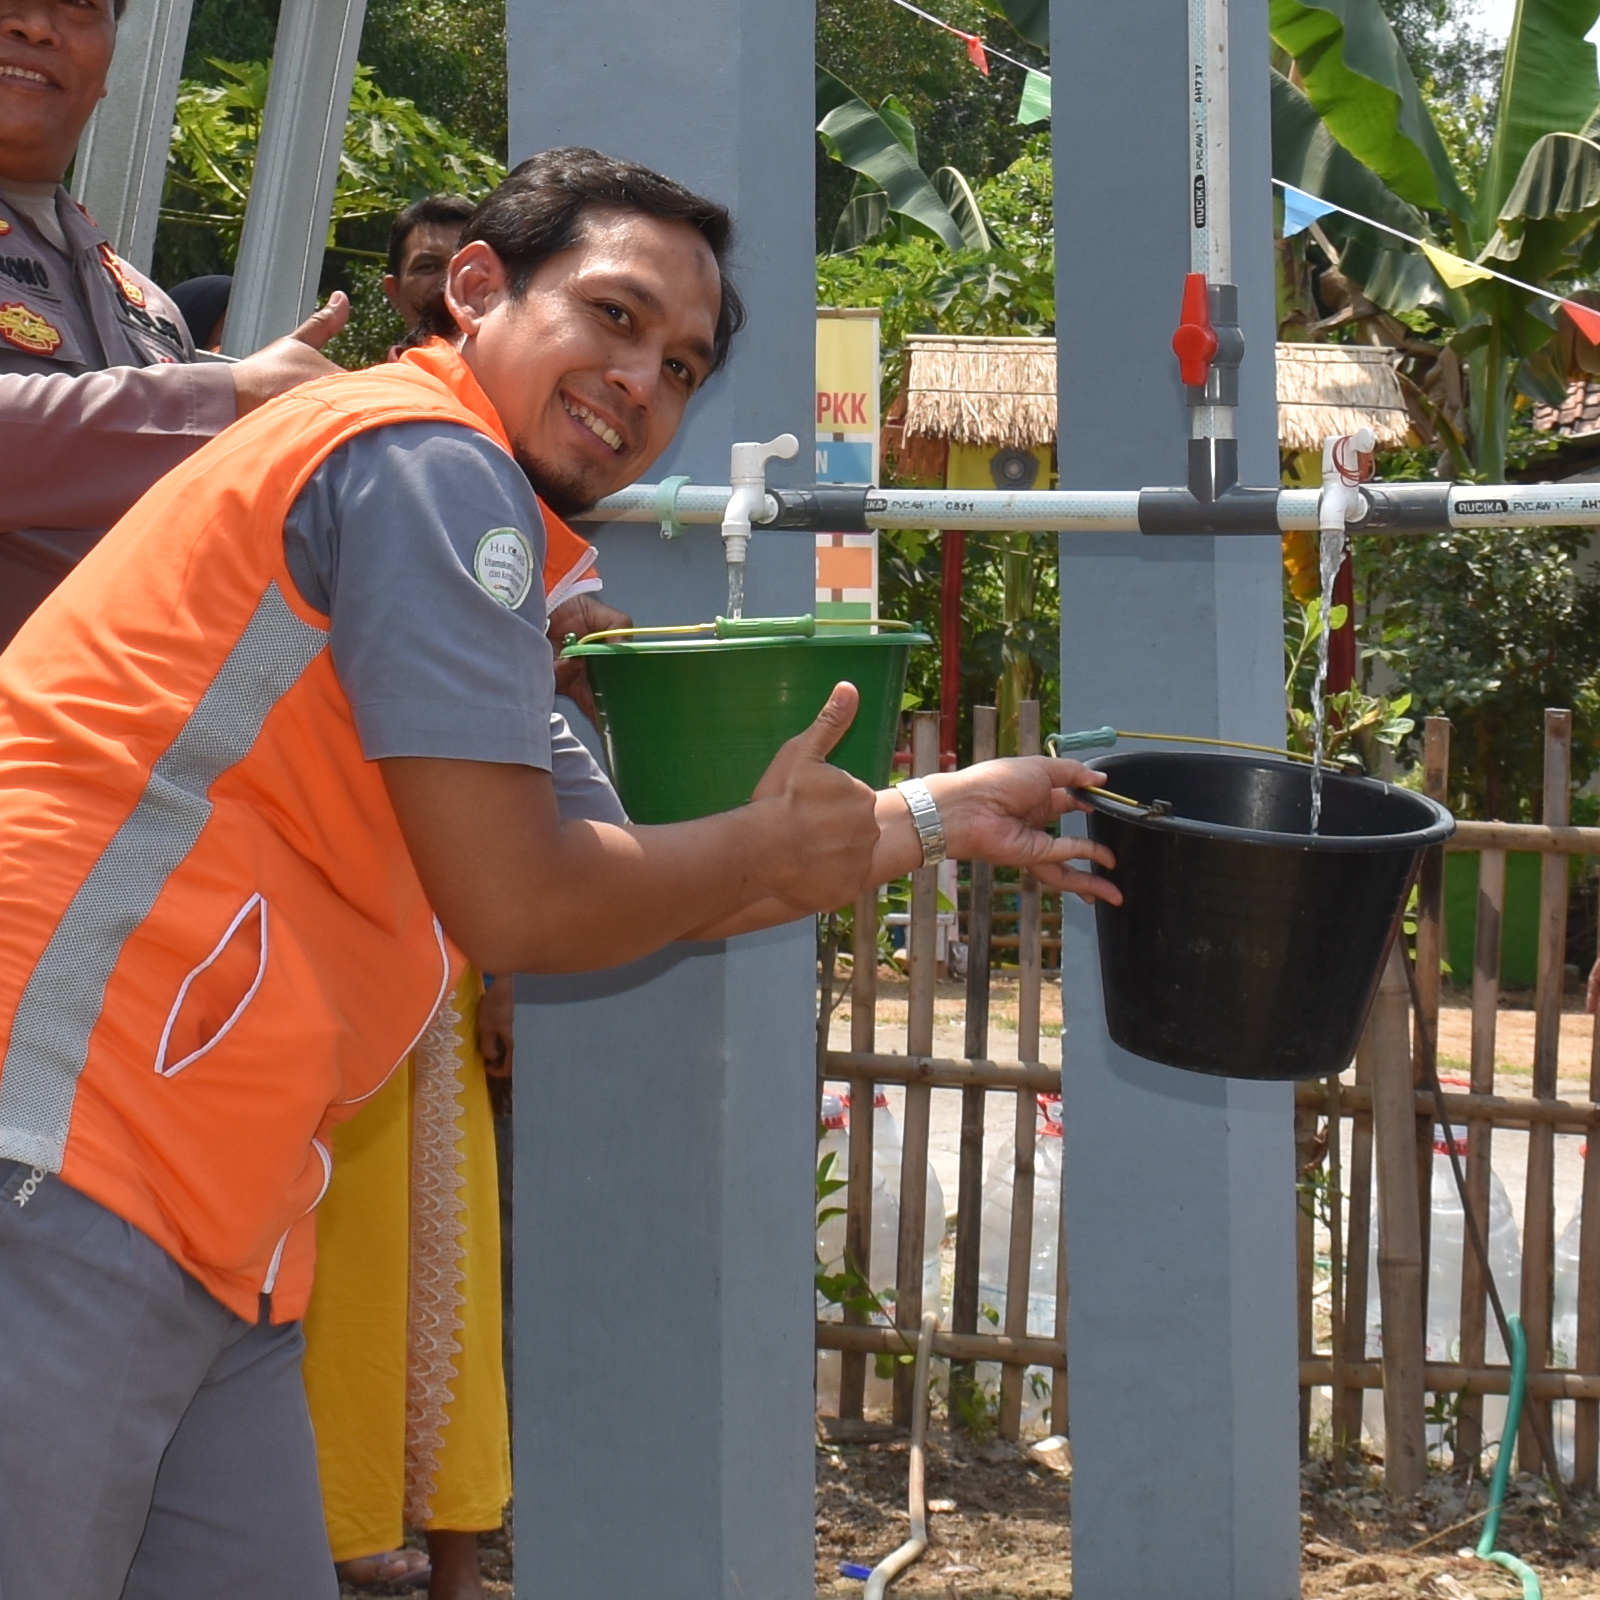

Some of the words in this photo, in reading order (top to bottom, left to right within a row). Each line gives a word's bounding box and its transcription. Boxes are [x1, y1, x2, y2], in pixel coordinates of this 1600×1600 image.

[1194, 64, 1203, 103] AH737
[1196, 179, 1205, 225] RUCIKA
[817, 392, 868, 425] PKK
[1457, 501, 1505, 513] RUCIKA
